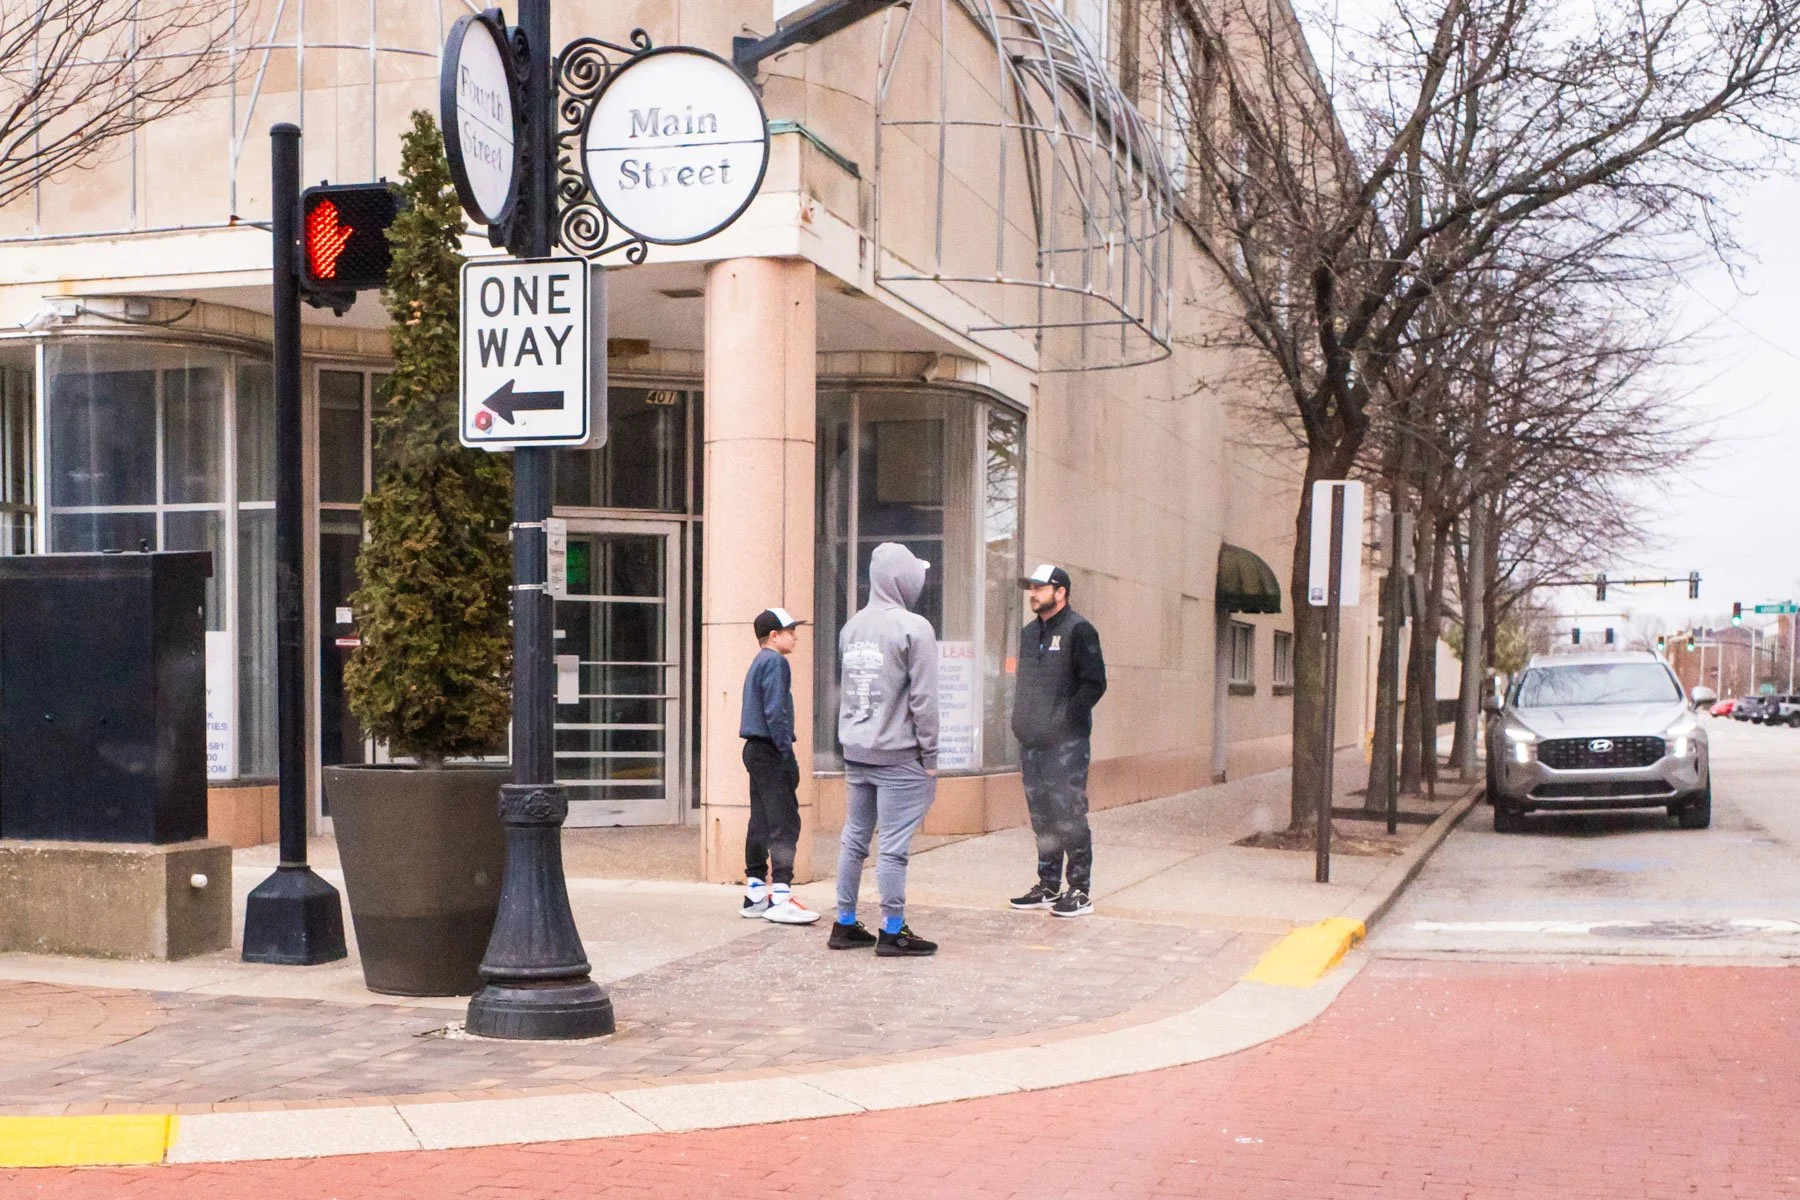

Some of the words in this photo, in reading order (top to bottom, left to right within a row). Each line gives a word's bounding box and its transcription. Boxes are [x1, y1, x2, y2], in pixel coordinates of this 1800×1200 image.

[461, 64, 504, 124] Fourth
[629, 104, 718, 138] Main
[463, 121, 502, 172] Street
[619, 159, 732, 190] Street
[480, 274, 571, 318] ONE
[477, 324, 574, 368] WAY
[647, 391, 674, 403] 401
[942, 646, 977, 659] LEAS
